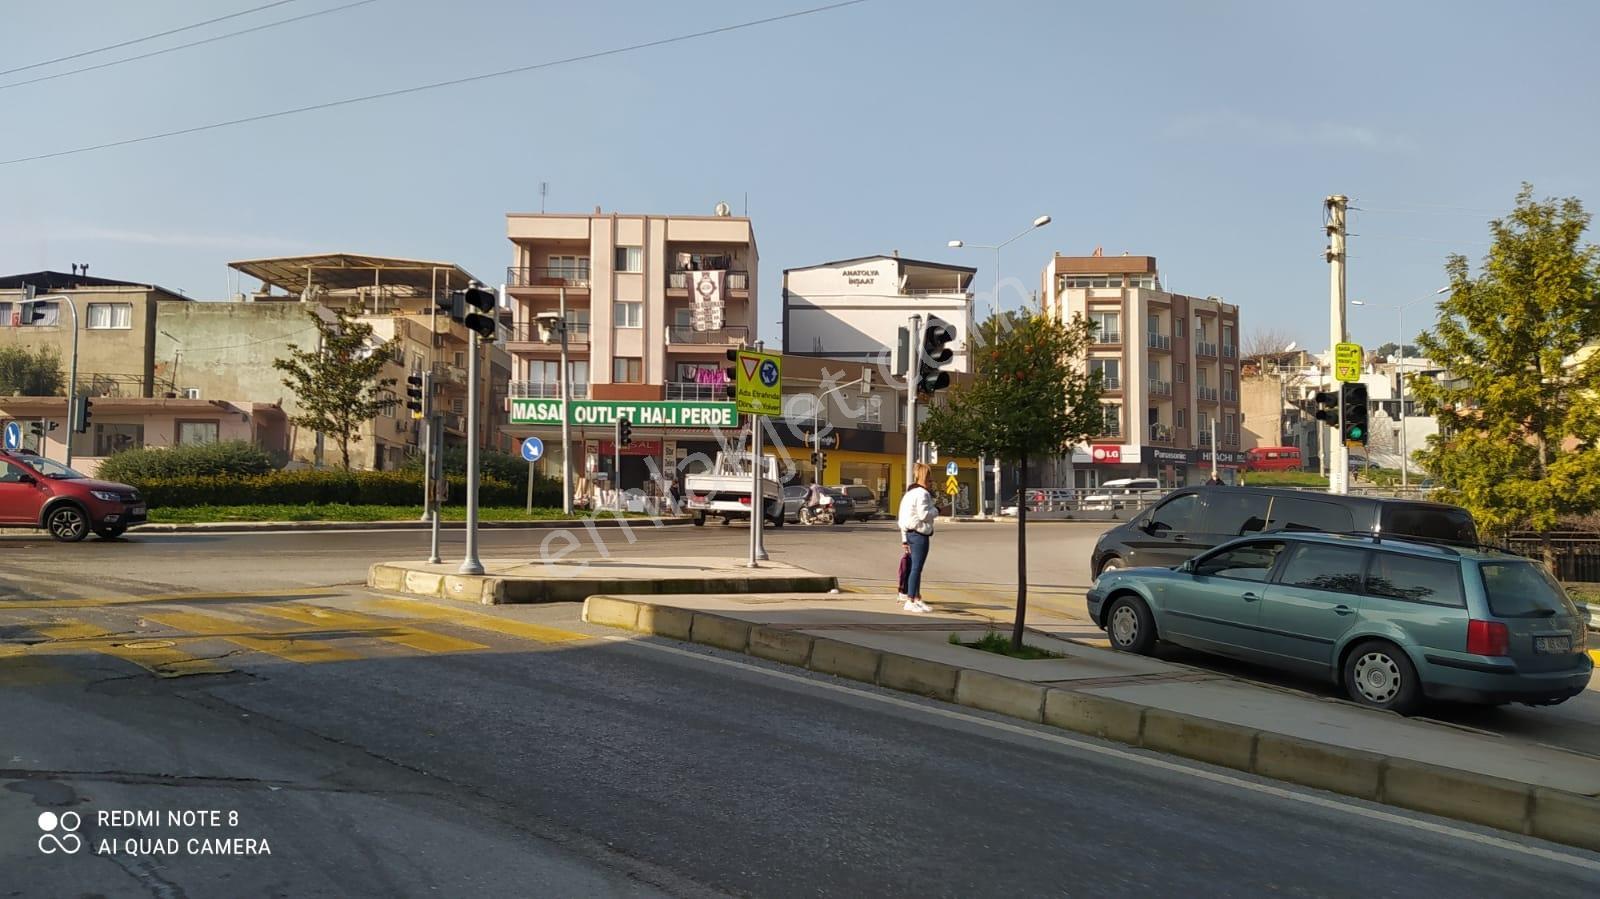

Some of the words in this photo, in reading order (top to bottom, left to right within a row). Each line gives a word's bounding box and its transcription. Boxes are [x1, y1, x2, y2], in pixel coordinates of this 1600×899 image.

[849, 278, 875, 287] İNŞAAT
[739, 388, 751, 396] Ada
[574, 406, 636, 424] OUTLET
[640, 407, 676, 424] HALI
[681, 408, 731, 425] PERDE
[1106, 450, 1119, 458] LG
[1153, 449, 1187, 460] Panasonic
